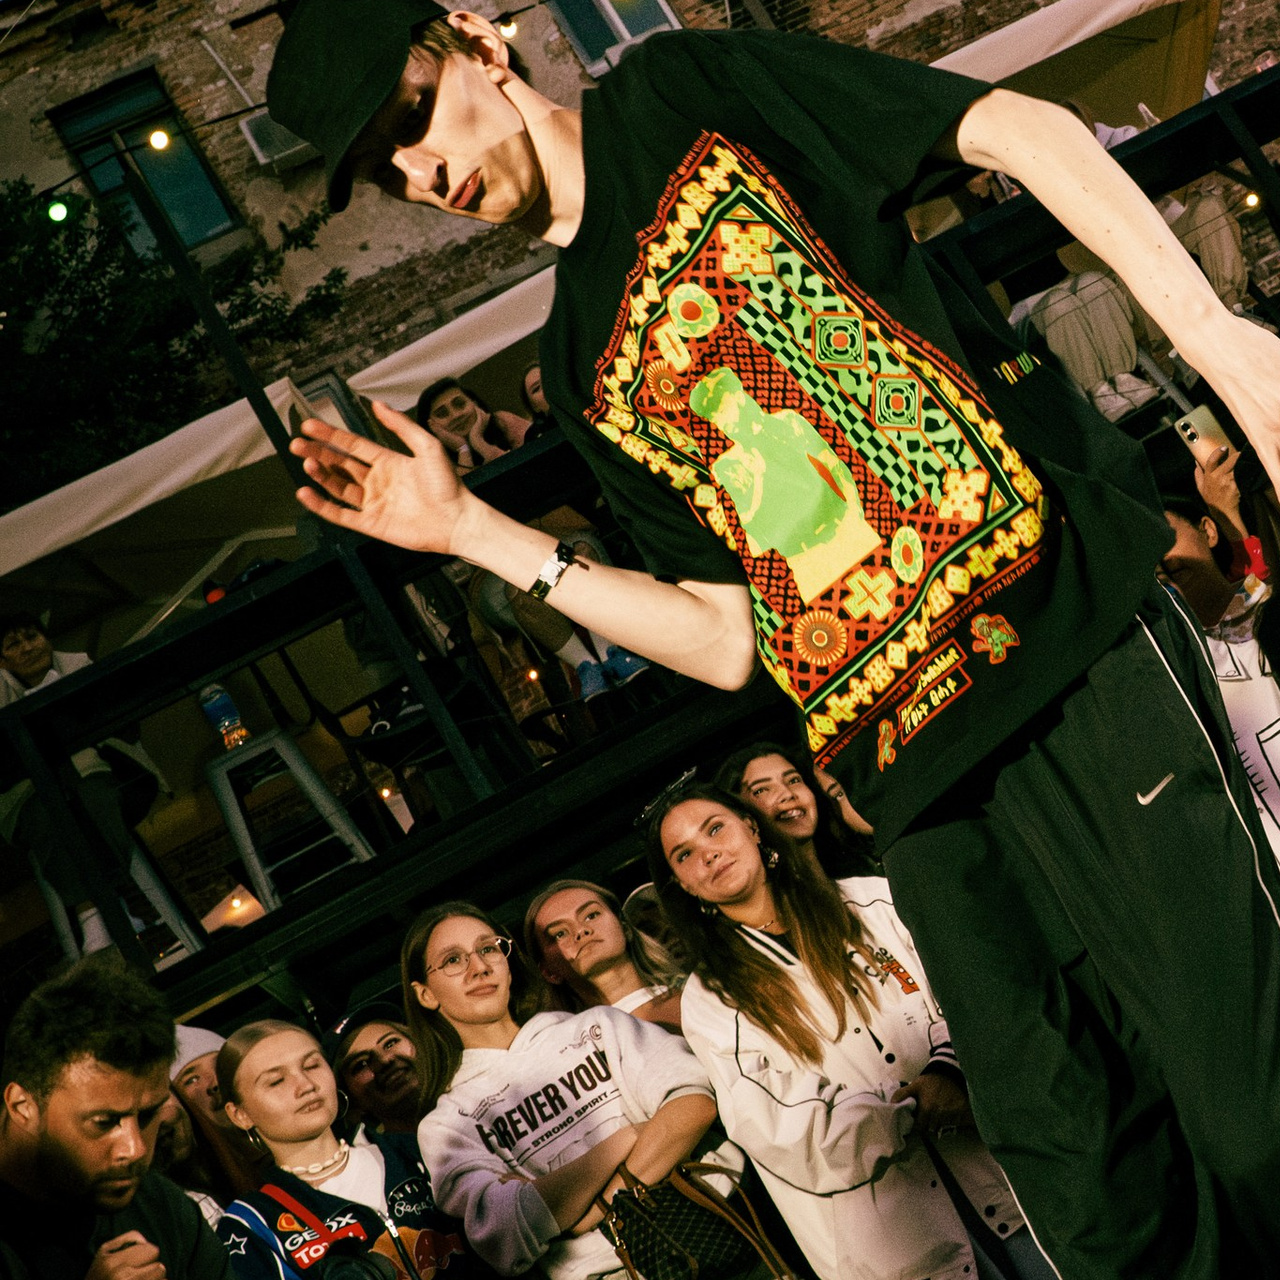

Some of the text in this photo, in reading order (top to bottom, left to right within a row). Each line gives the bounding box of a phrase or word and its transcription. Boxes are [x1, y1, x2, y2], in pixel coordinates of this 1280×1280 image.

[475, 1083, 568, 1154] FREVER
[531, 1091, 609, 1147] STRONG SPIRIT
